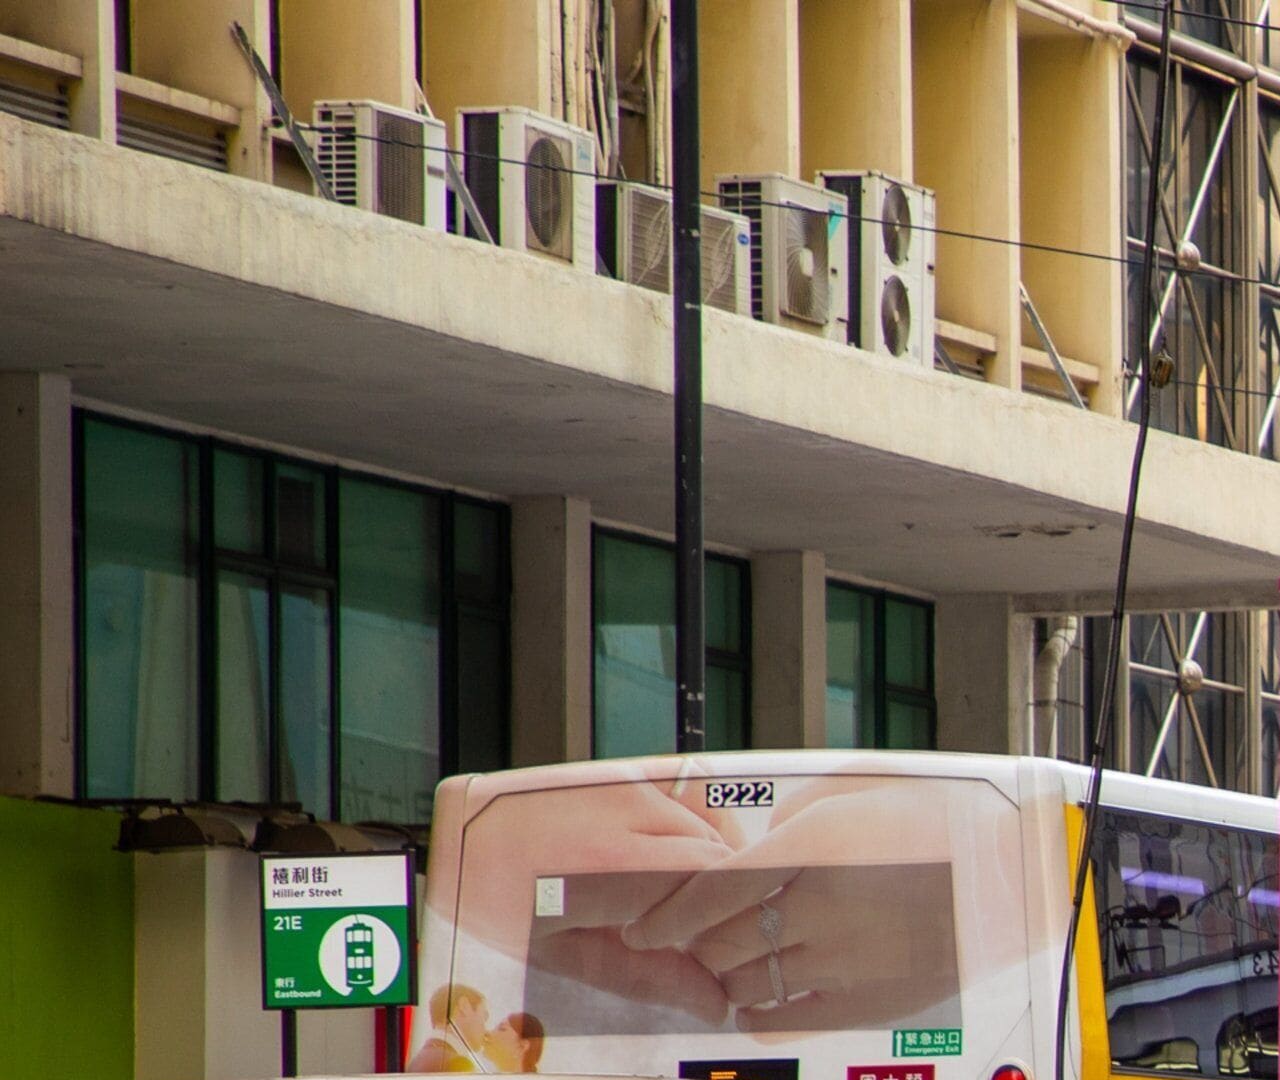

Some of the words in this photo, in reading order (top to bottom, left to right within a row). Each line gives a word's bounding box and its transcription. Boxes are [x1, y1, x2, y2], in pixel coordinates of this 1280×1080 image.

[707, 782, 773, 807] 8222
[272, 866, 328, 885] 禧利街
[272, 889, 305, 898] Hillier
[308, 887, 343, 897] Street
[273, 915, 303, 931] 21E
[274, 988, 322, 999] Eastbound
[904, 1030, 960, 1046] 緊急出口
[904, 1045, 944, 1056] Emergency
[945, 1045, 960, 1054] Exit
